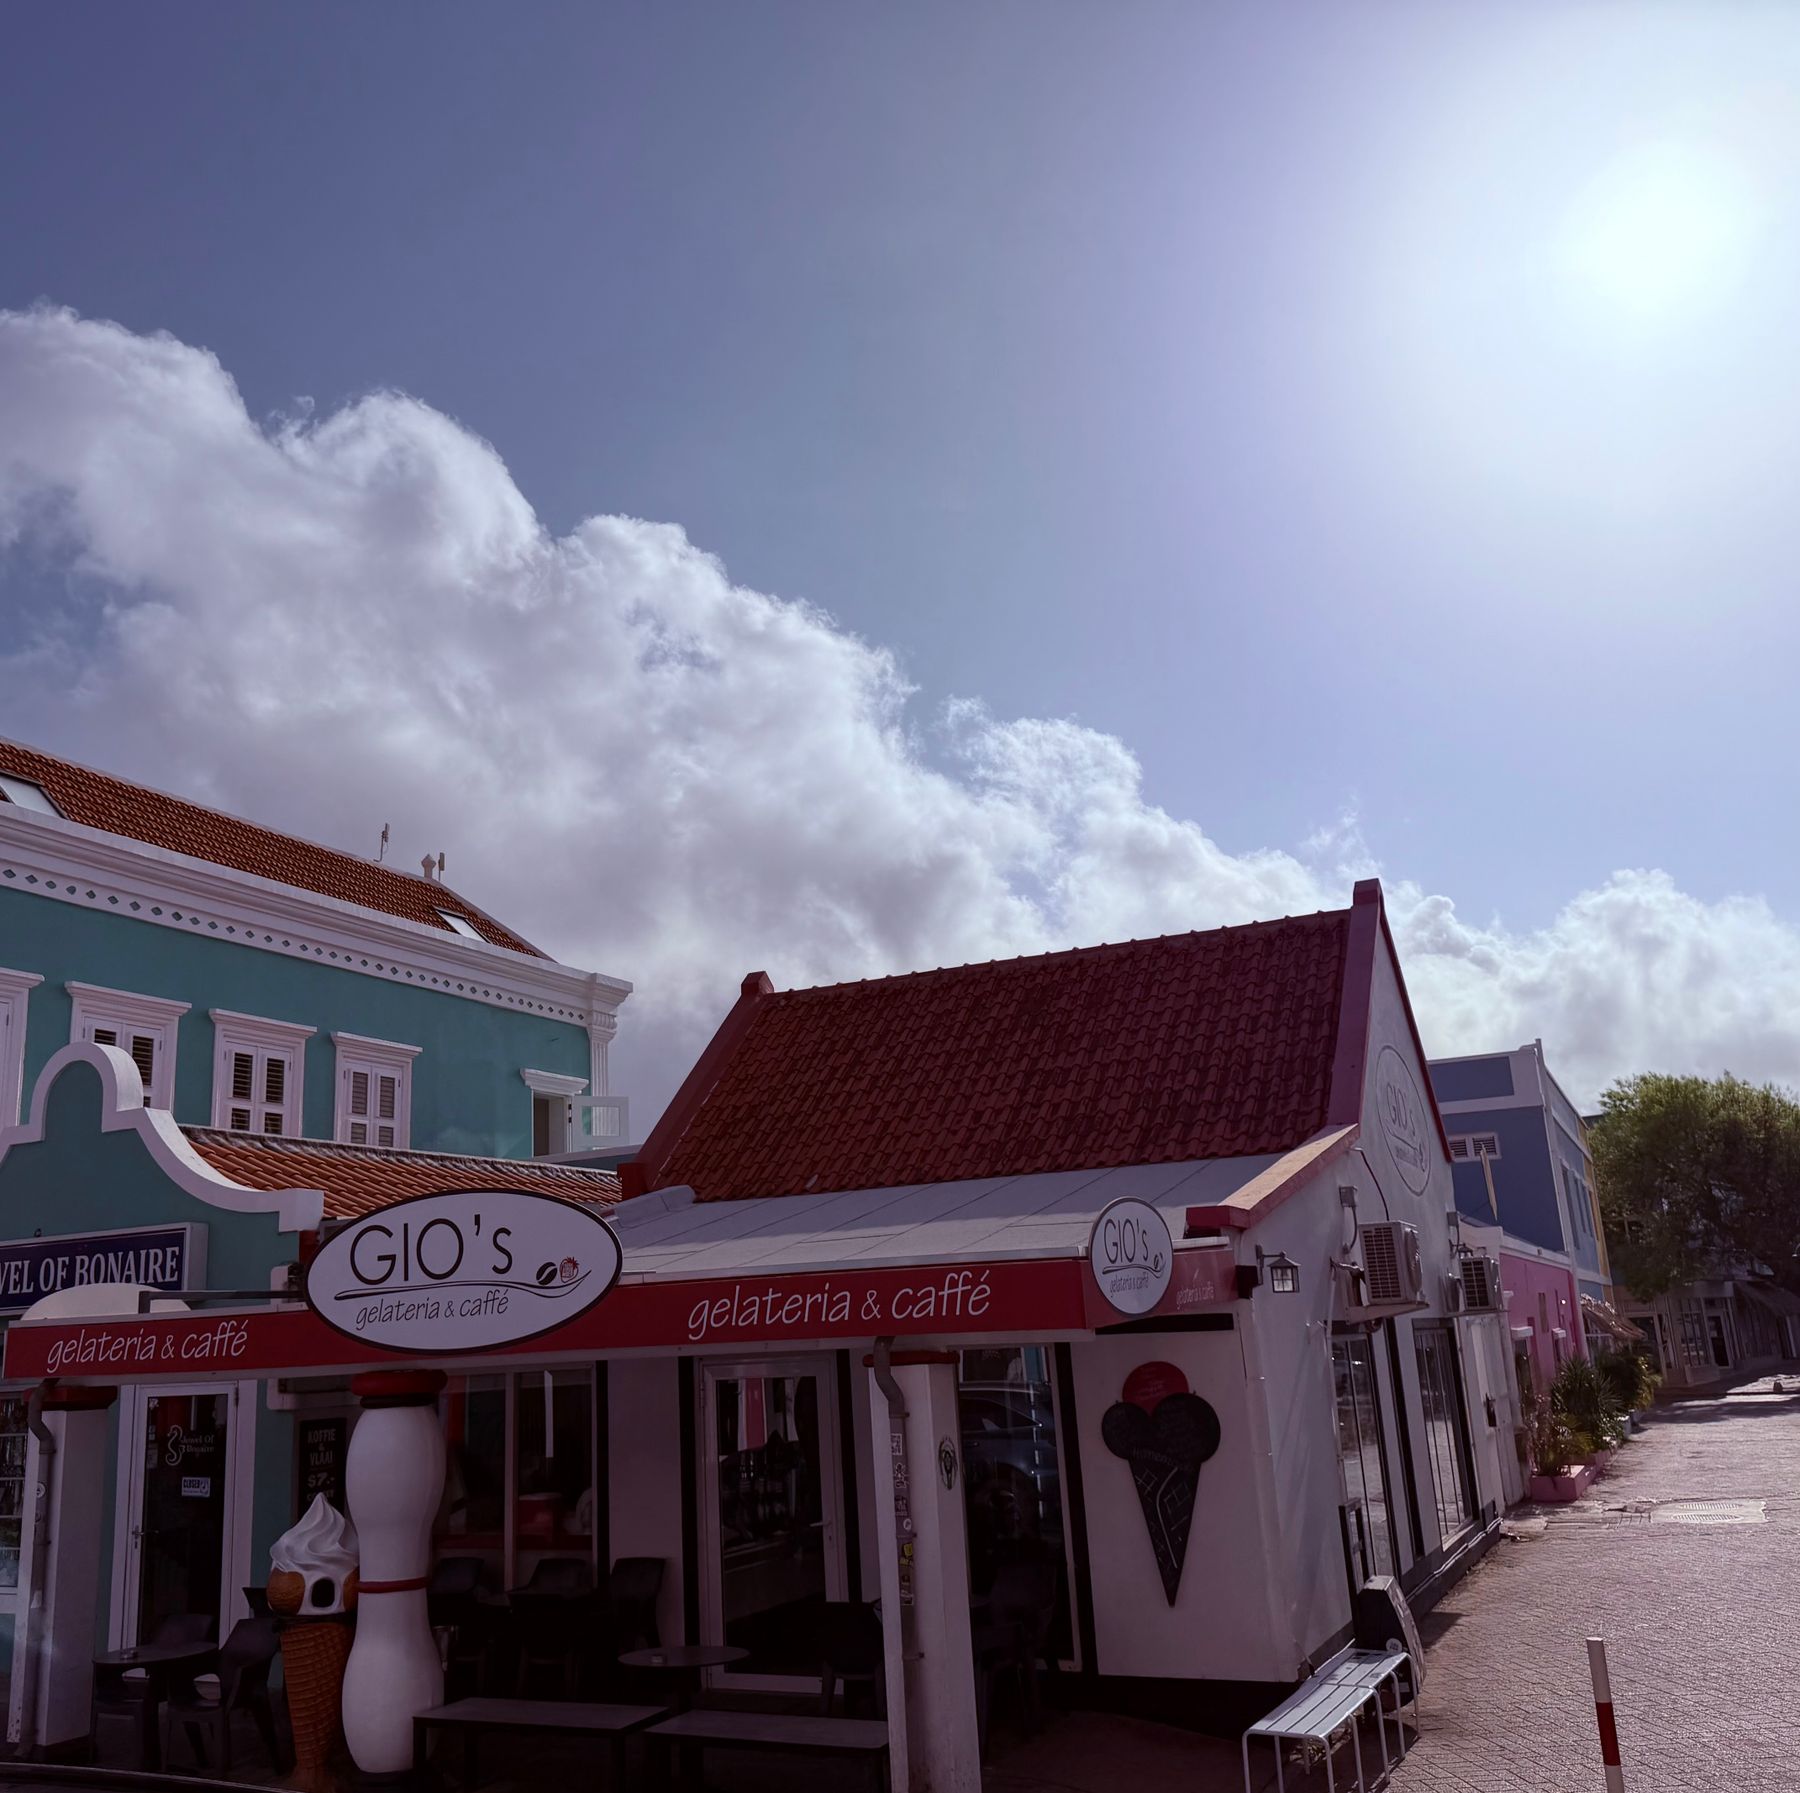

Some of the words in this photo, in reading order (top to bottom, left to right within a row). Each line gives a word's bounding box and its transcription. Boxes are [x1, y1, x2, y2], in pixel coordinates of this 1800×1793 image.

[350, 1214, 513, 1285] GIO's
[1104, 1218, 1148, 1264] GIO's
[39, 1256, 70, 1291] OF
[75, 1246, 180, 1286] BONAIRE
[355, 1297, 440, 1331] gelateria
[444, 1300, 455, 1318] &
[459, 1289, 509, 1317] caffé
[688, 1282, 850, 1341] gelateria
[861, 1289, 882, 1321] &
[891, 1269, 990, 1320] caffé
[46, 1327, 157, 1374] gelateria
[160, 1334, 175, 1360] &
[180, 1319, 249, 1360] caffé
